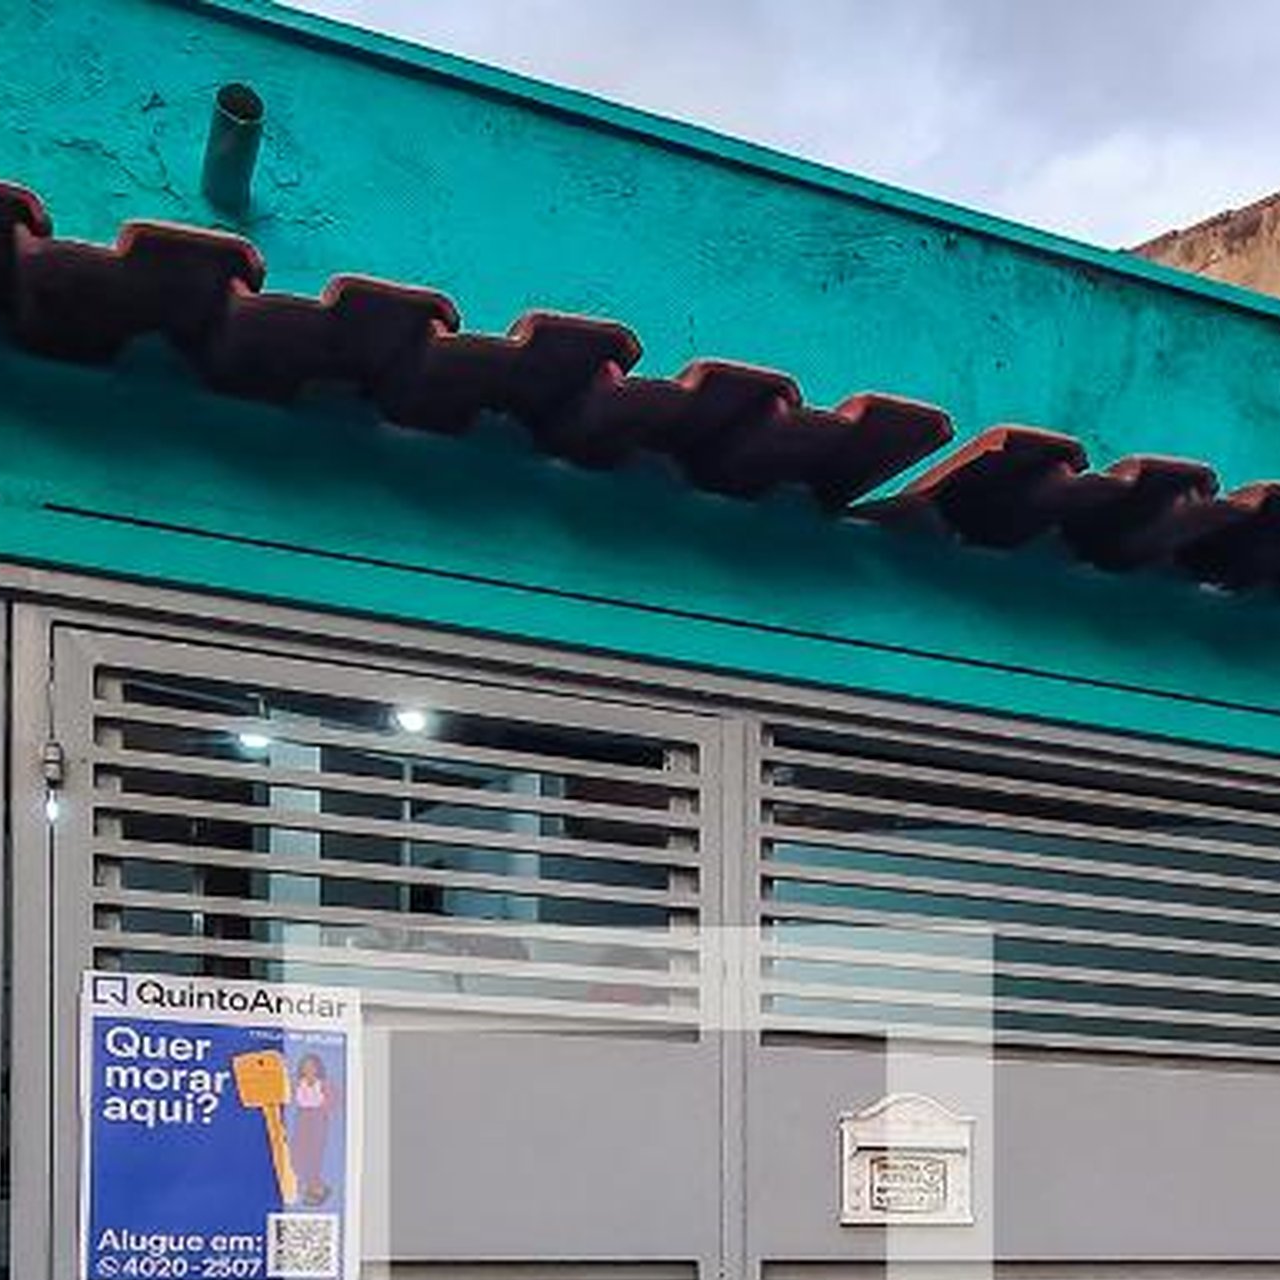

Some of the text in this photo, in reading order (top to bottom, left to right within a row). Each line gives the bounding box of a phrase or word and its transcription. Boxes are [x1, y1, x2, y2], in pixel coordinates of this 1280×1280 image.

[136, 979, 346, 1017] QuintoAndar
[106, 1027, 211, 1060] Quer
[105, 1066, 230, 1094] morar
[103, 1094, 218, 1127] aqui?
[98, 1229, 263, 1257] Alugue em:
